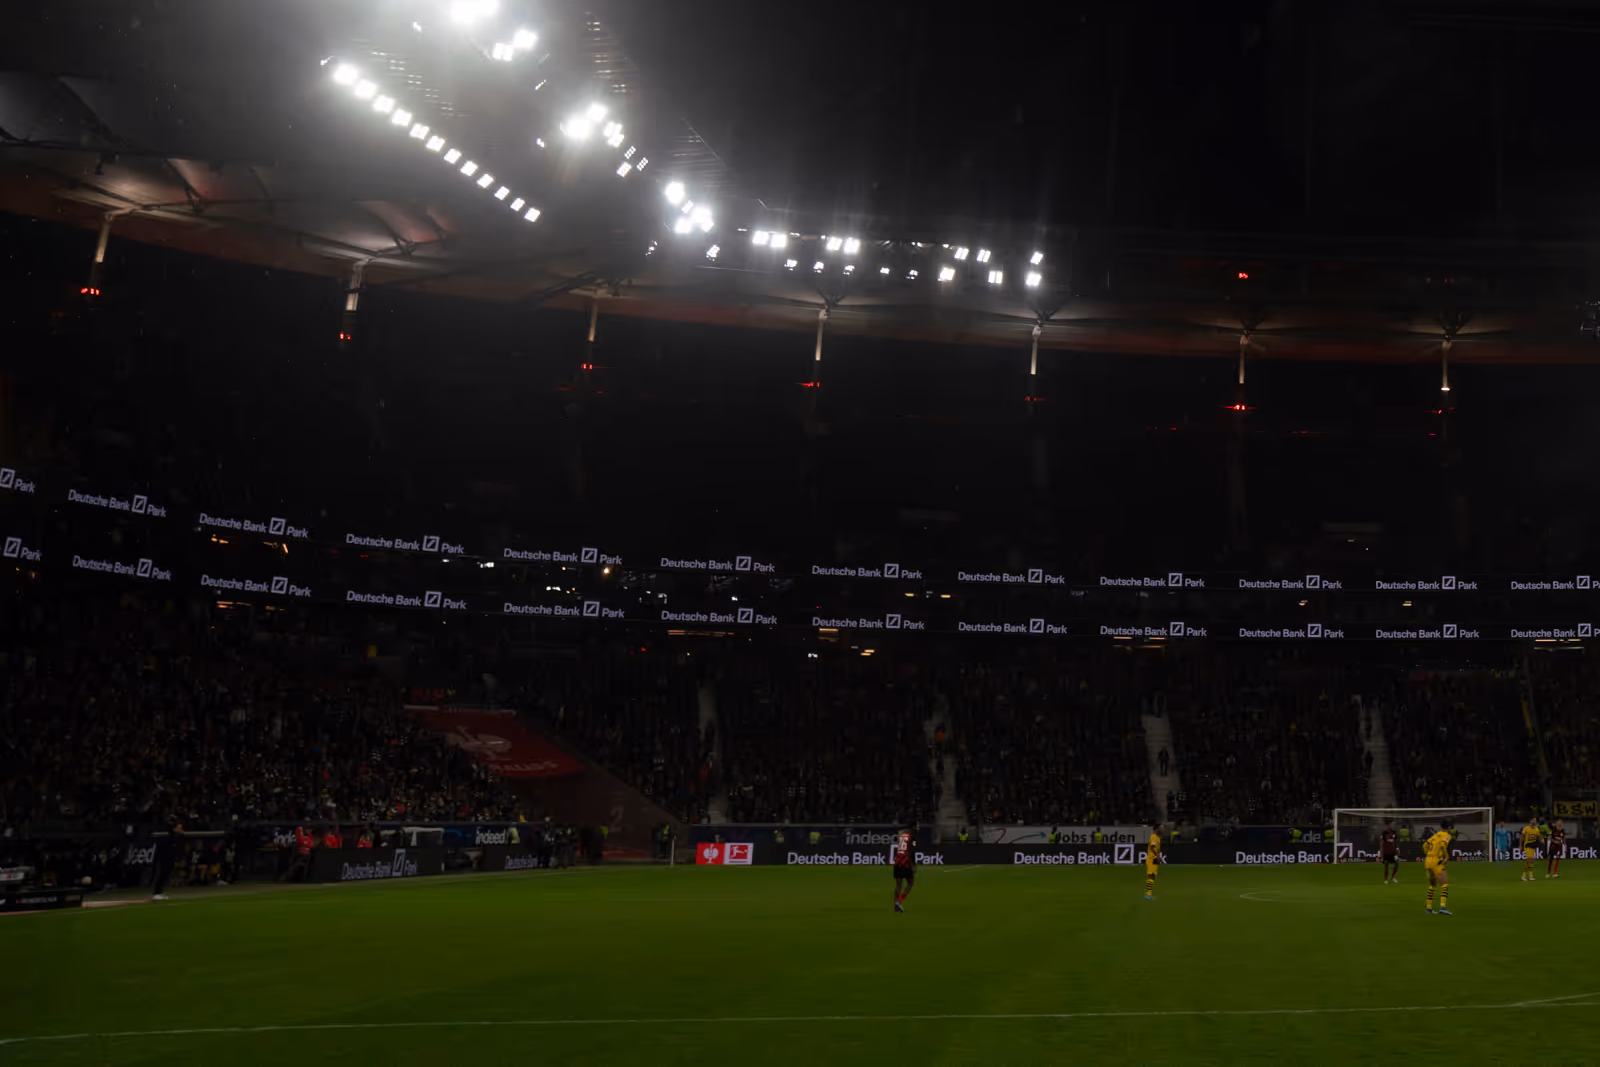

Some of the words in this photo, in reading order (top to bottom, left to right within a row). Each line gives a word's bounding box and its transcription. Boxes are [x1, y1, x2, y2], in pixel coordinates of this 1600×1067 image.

[14, 477, 36, 493] Park
[67, 488, 109, 508] Deutsche
[108, 496, 130, 511] Bank
[146, 503, 167, 518] Park
[198, 512, 242, 530] Deutsche
[242, 519, 267, 533] Bank
[286, 525, 309, 539] Park
[345, 533, 393, 548] Deutsche
[394, 538, 420, 551] Bank
[440, 542, 465, 555] Park
[20, 546, 42, 561] Park
[503, 547, 552, 561] Deutsche
[552, 551, 579, 563] Bank
[599, 553, 623, 565] Park
[72, 554, 114, 573] Deutsche
[113, 561, 136, 575] Bank
[151, 567, 172, 581] Park
[660, 557, 707, 569] Deutsche
[708, 559, 733, 571] Bank
[753, 562, 775, 573] Park
[811, 564, 857, 577] Deutsche
[857, 567, 882, 578] Bank
[901, 569, 923, 580] Park
[1099, 576, 1143, 587] Deutsche
[1143, 577, 1167, 587] Bank
[1184, 578, 1205, 588] Park
[1239, 578, 1281, 589] Deutsche
[1281, 579, 1304, 589] Bank
[1322, 579, 1342, 589] Park
[1510, 580, 1552, 590] Deutsche
[1552, 580, 1575, 590] Bank
[346, 590, 394, 605] Deutsche
[395, 594, 422, 607] Bank
[442, 598, 467, 610] Park
[475, 827, 505, 844] indeed
[1091, 831, 1135, 843] fnden
[787, 851, 849, 865] Deutsche
[852, 851, 885, 865] Bank
[914, 852, 944, 865] Park
[1013, 851, 1075, 865] Deutsche
[1077, 851, 1110, 865] Bank
[1138, 851, 1167, 865] Pk
[1235, 851, 1295, 864] Deutsche
[1513, 847, 1544, 859] Bak
[1569, 847, 1598, 859] Park
[341, 862, 374, 880] Deutsche
